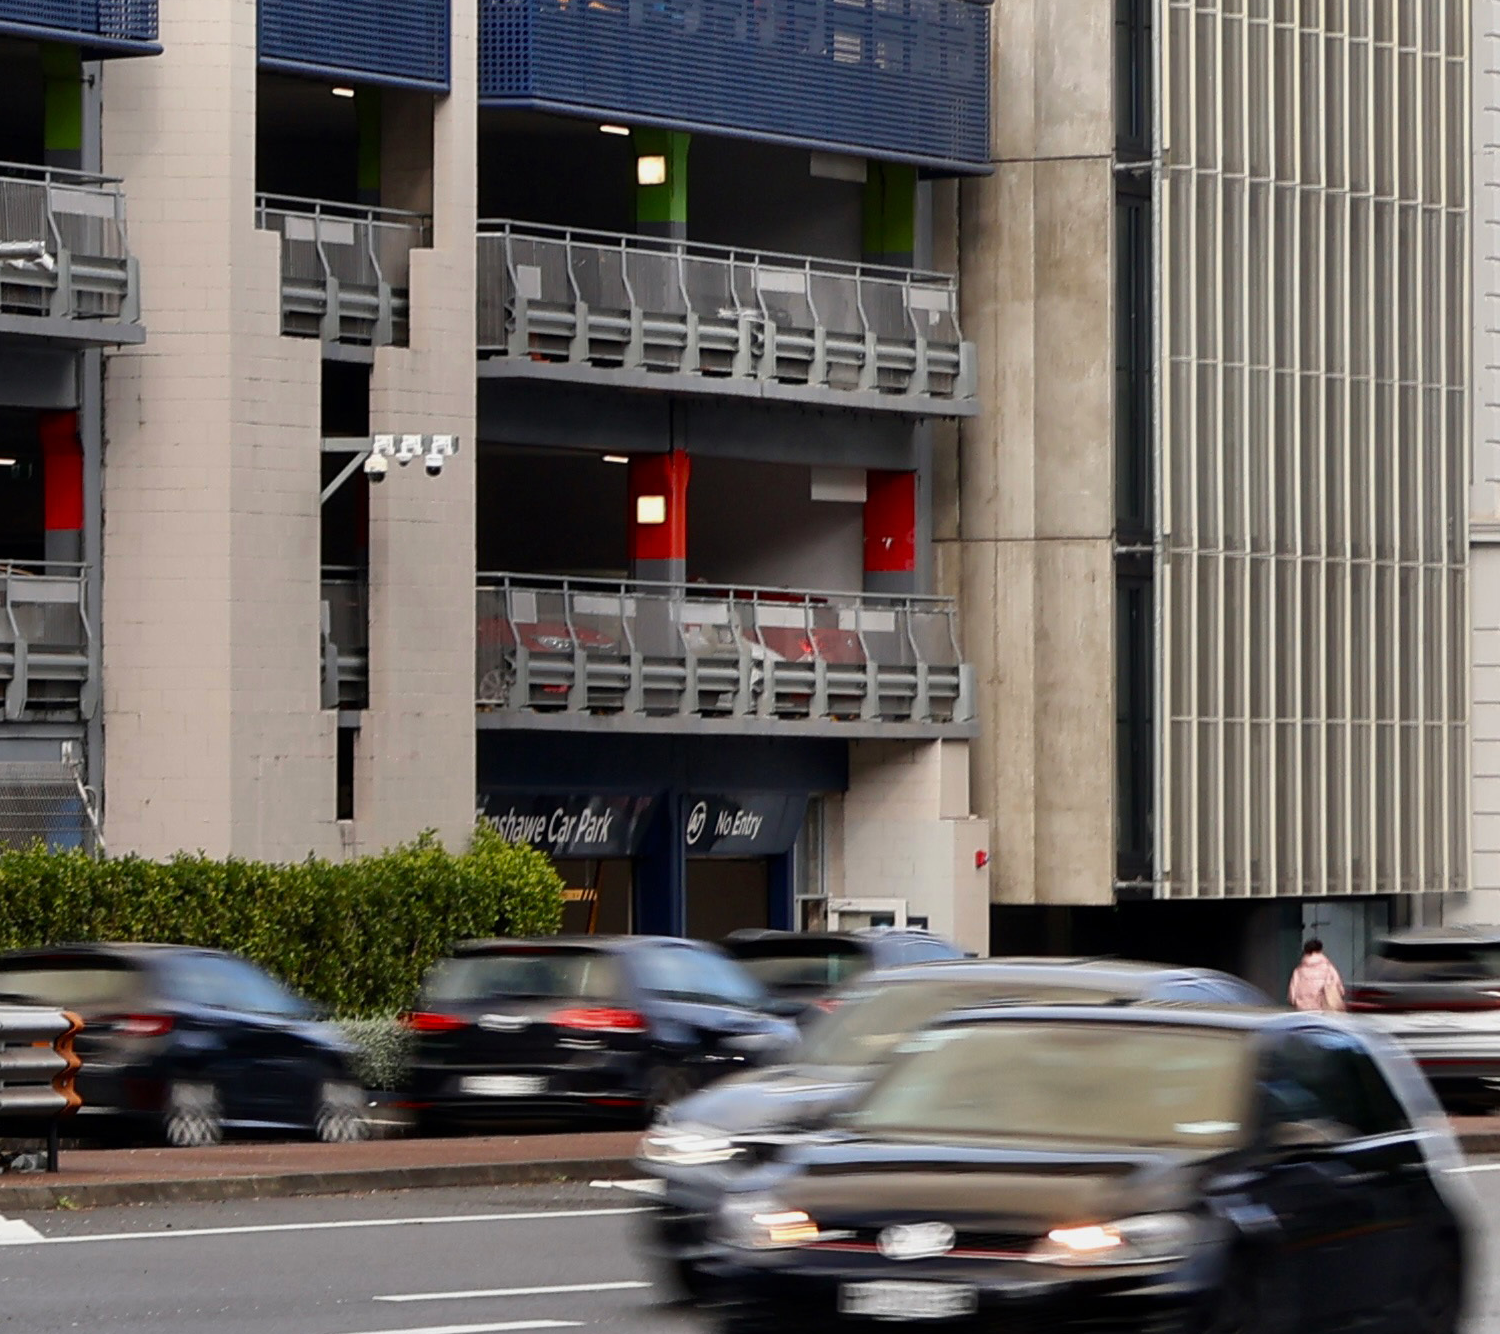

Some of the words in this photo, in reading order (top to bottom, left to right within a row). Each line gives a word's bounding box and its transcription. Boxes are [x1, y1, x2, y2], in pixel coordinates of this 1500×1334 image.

[547, 806, 573, 843] Car
[575, 806, 614, 843] Park
[714, 809, 733, 836] No
[731, 809, 764, 840] Entry
